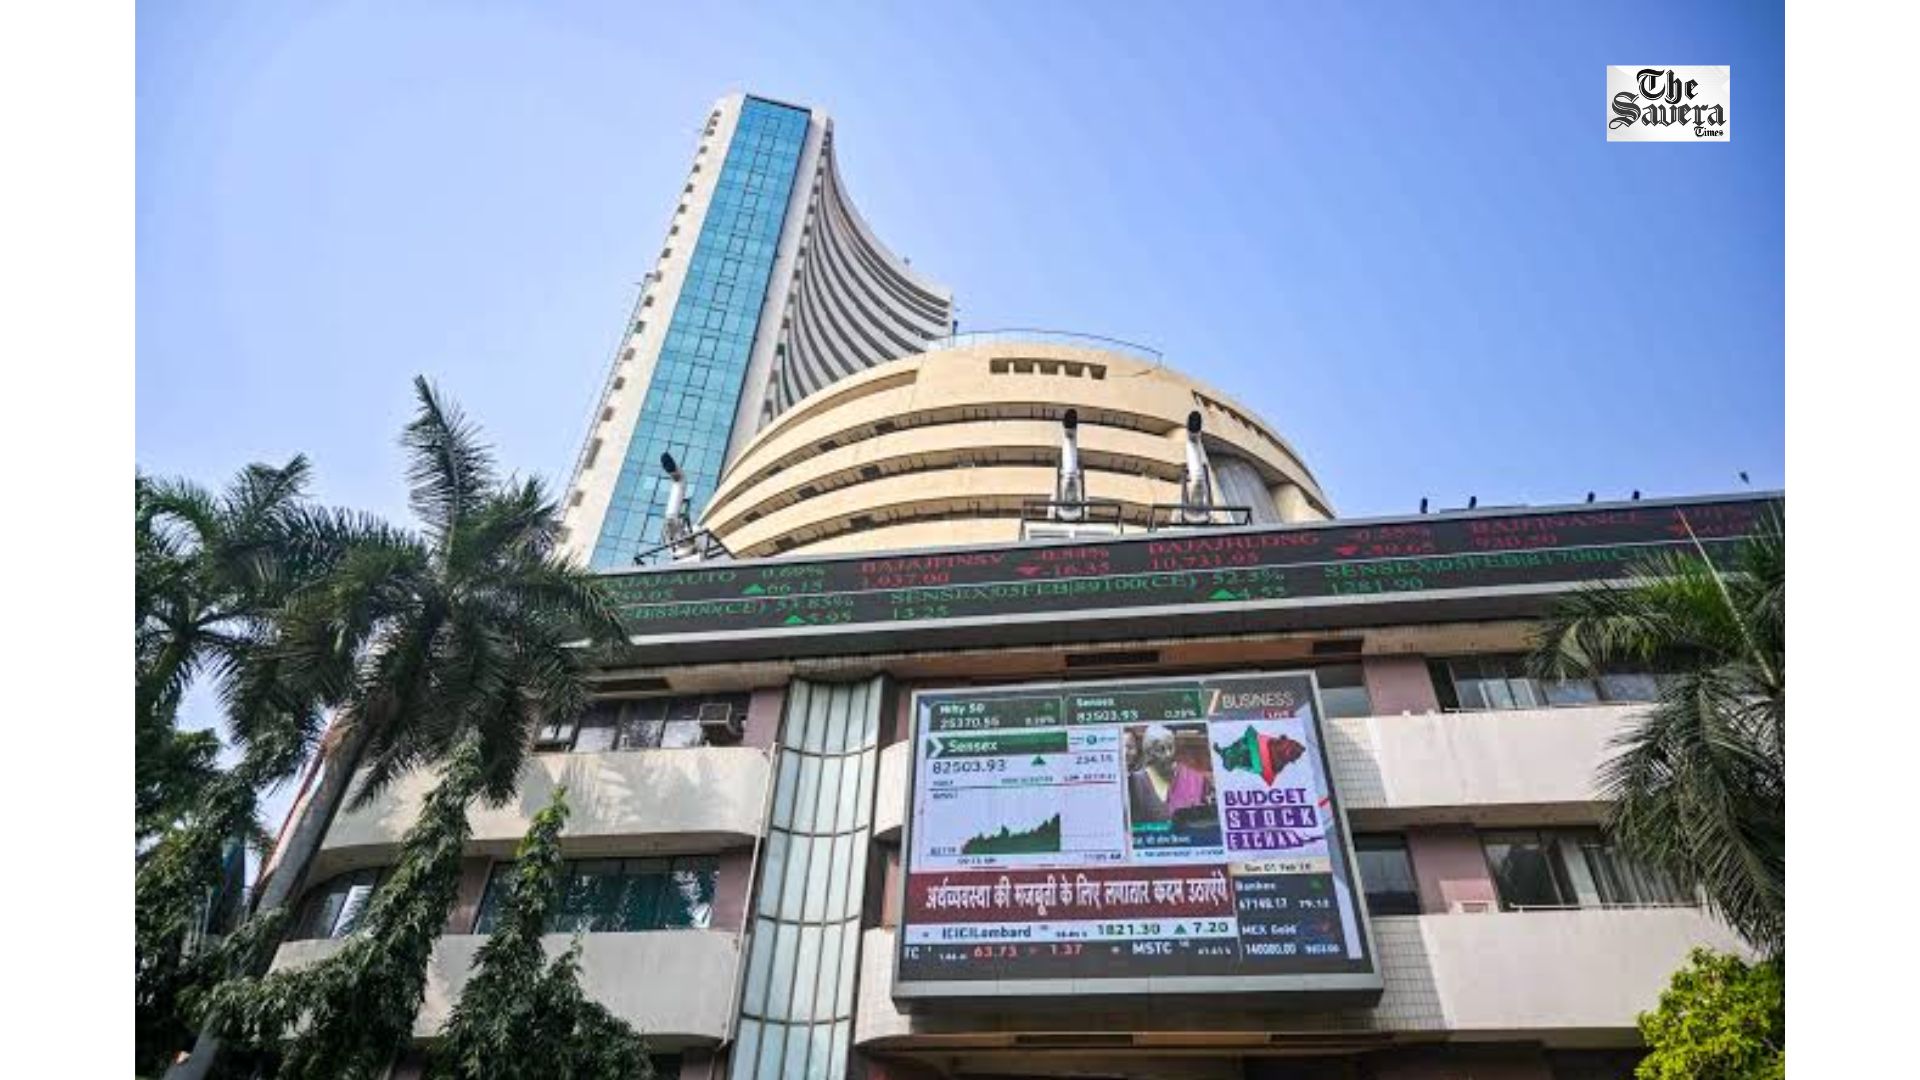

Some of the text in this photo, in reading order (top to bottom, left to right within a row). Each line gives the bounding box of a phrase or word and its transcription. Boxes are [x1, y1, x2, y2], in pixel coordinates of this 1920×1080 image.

[1222, 691, 1295, 710] BUSINESS
[940, 703, 985, 715] Nifty 50
[1077, 710, 1139, 722] 82503.93
[948, 739, 998, 753] Sensex
[933, 759, 1007, 775] 82503.93
[1225, 788, 1306, 806] BUDGET
[1229, 808, 1316, 828] STOCK
[994, 875, 1011, 908] की
[1059, 873, 1073, 906] के
[1075, 873, 1102, 909] लिए
[1097, 923, 1161, 936] 1821.30
[1193, 921, 1229, 934] 7.20
[974, 945, 1018, 958] 63.73
[1051, 943, 1083, 956] 1.37
[1132, 941, 1173, 955] MSTC
